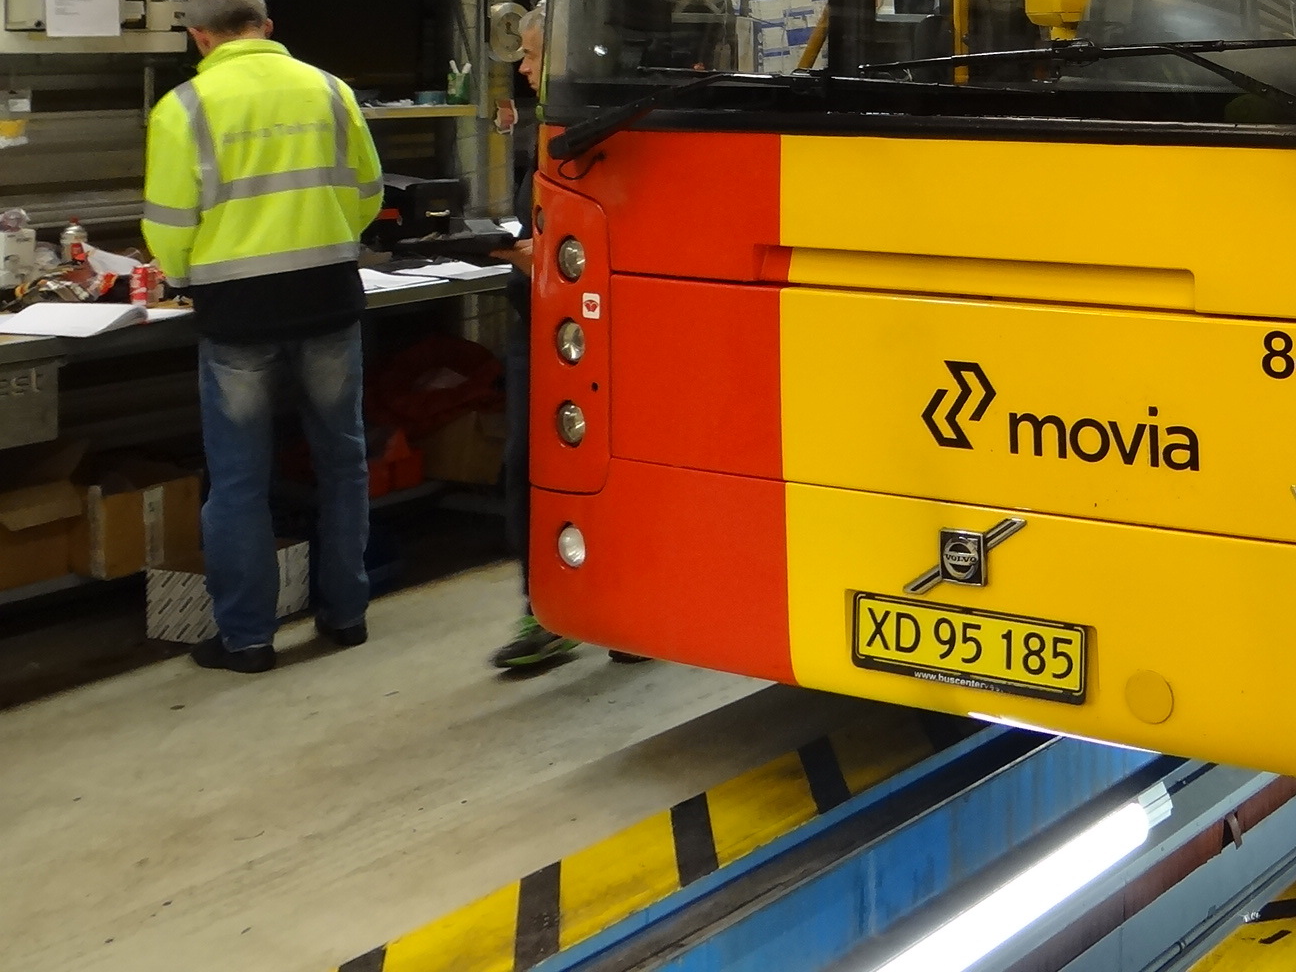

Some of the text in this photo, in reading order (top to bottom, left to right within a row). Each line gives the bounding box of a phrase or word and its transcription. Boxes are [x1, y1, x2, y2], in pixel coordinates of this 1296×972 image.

[1008, 406, 1201, 472] movia
[944, 553, 977, 564] VOLVO
[866, 608, 1074, 679] XD 95 185
